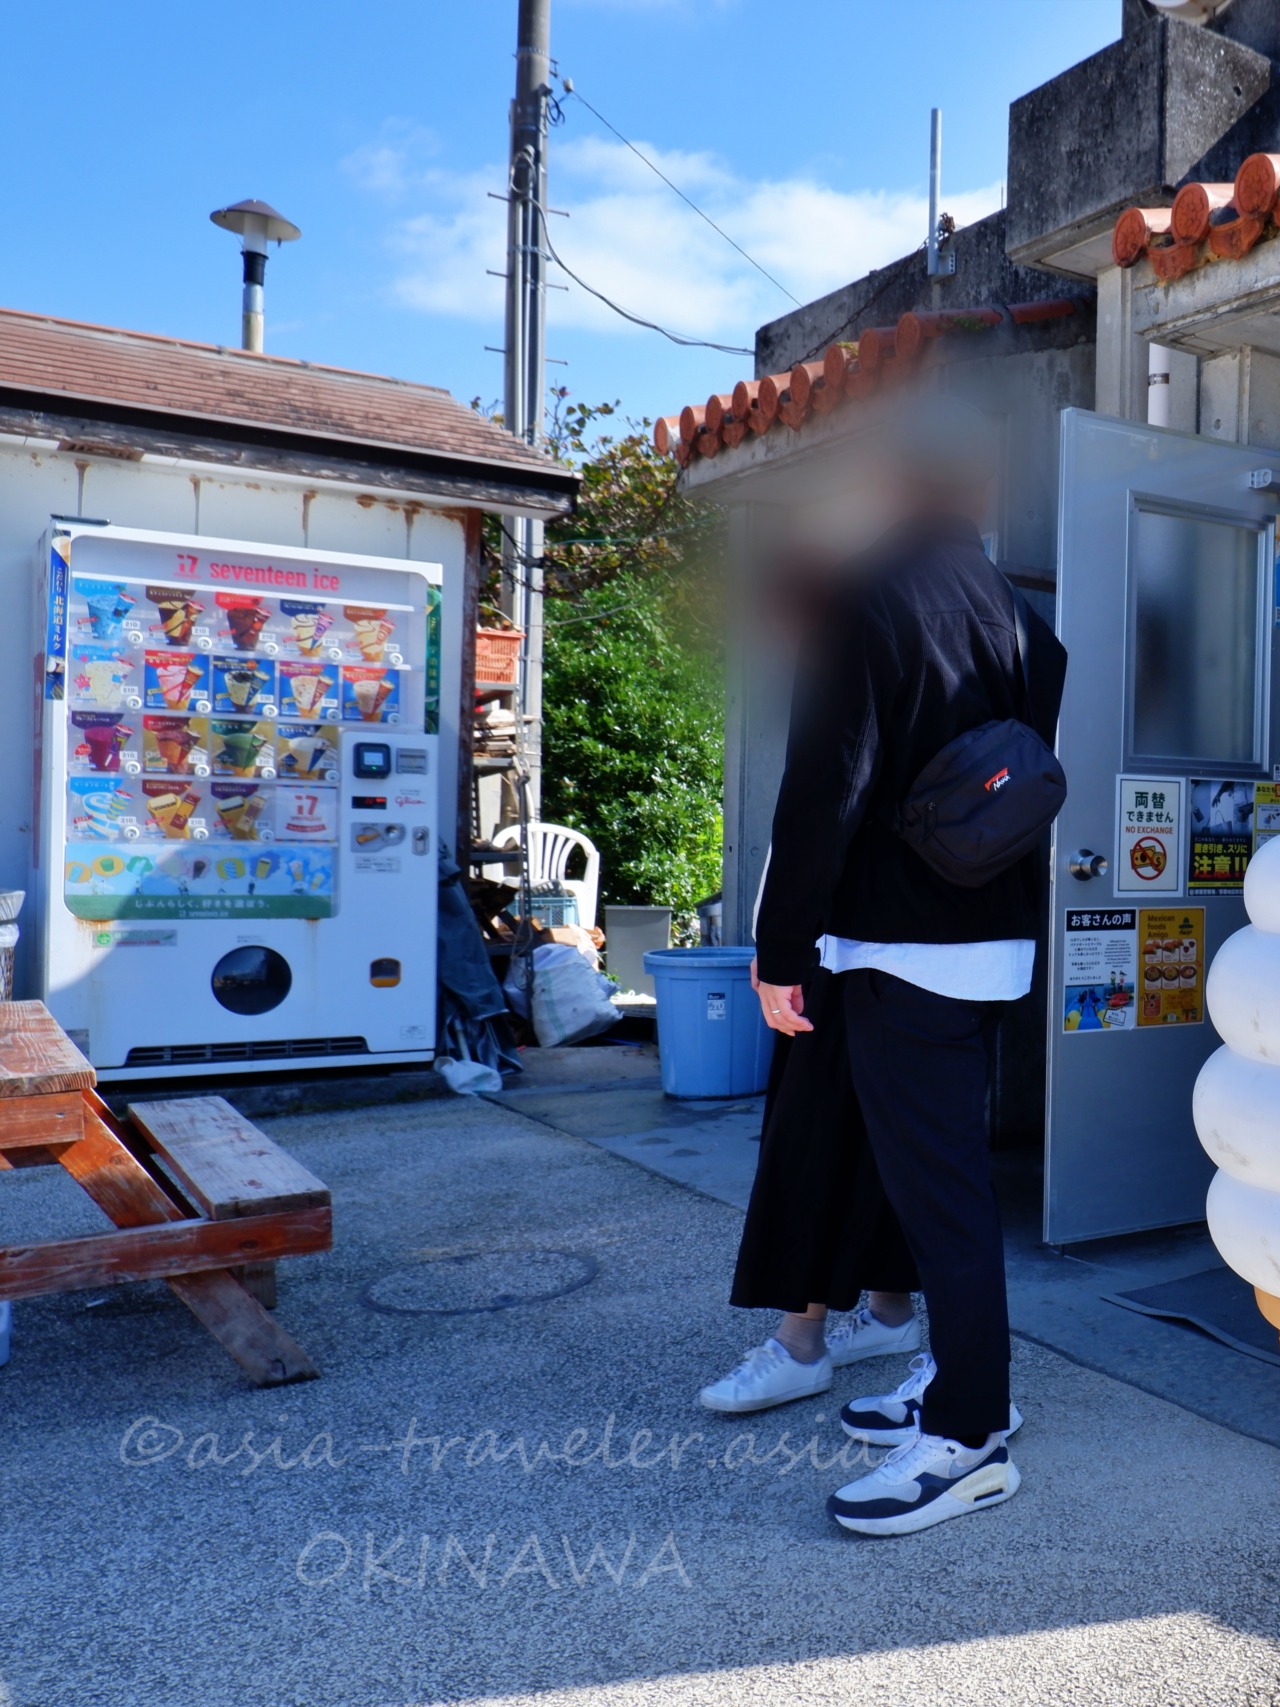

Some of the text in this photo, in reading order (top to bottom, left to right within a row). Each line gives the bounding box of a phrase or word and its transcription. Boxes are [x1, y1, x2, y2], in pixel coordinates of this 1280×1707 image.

[210, 562, 308, 588] seventeen
[313, 568, 340, 591] ice
[53, 595, 65, 650] 北海道ミルク
[1135, 791, 1166, 809] 両替
[1126, 811, 1174, 823] できません
[1125, 826, 1174, 835] NO EXCHANGE
[1071, 913, 1132, 927] お客さんの声
[1148, 914, 1176, 922] Mexican
[1147, 931, 1169, 939] Amigo
